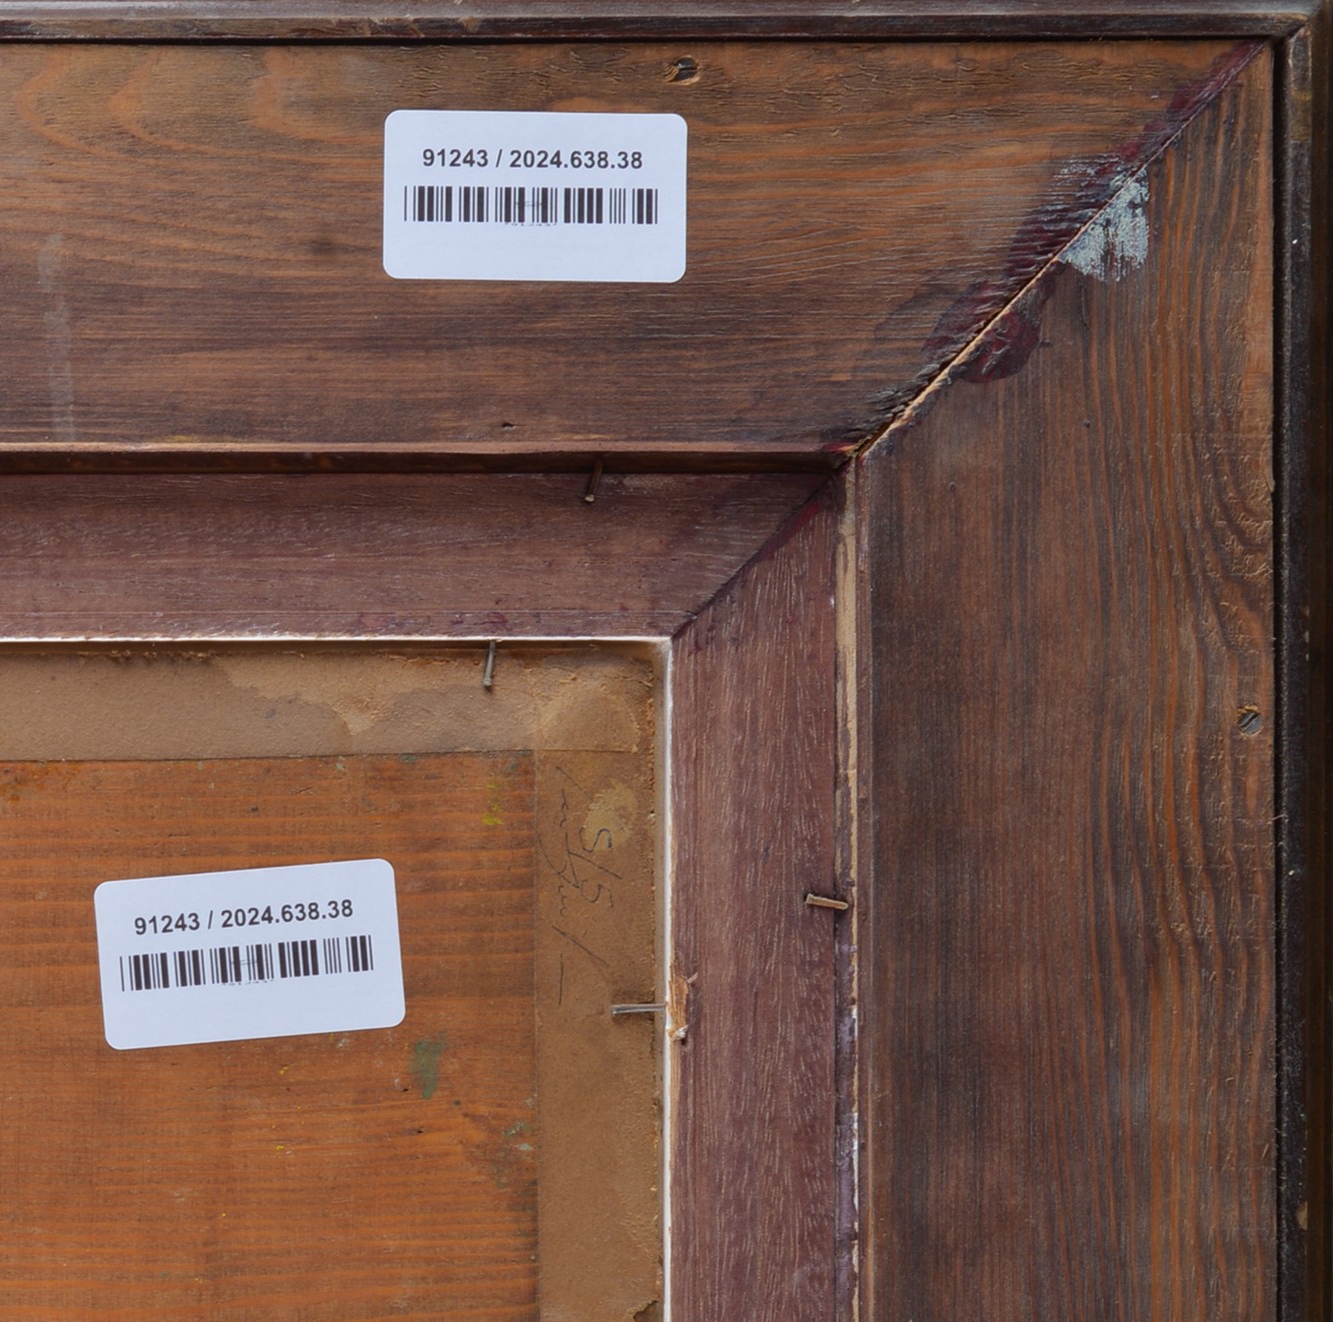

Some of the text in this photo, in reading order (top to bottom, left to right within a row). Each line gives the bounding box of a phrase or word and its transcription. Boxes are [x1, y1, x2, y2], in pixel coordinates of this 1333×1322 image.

[422, 148, 643, 170] 91243 / 2024.638.38
[134, 899, 354, 936] 91243 / 2024.638.38
